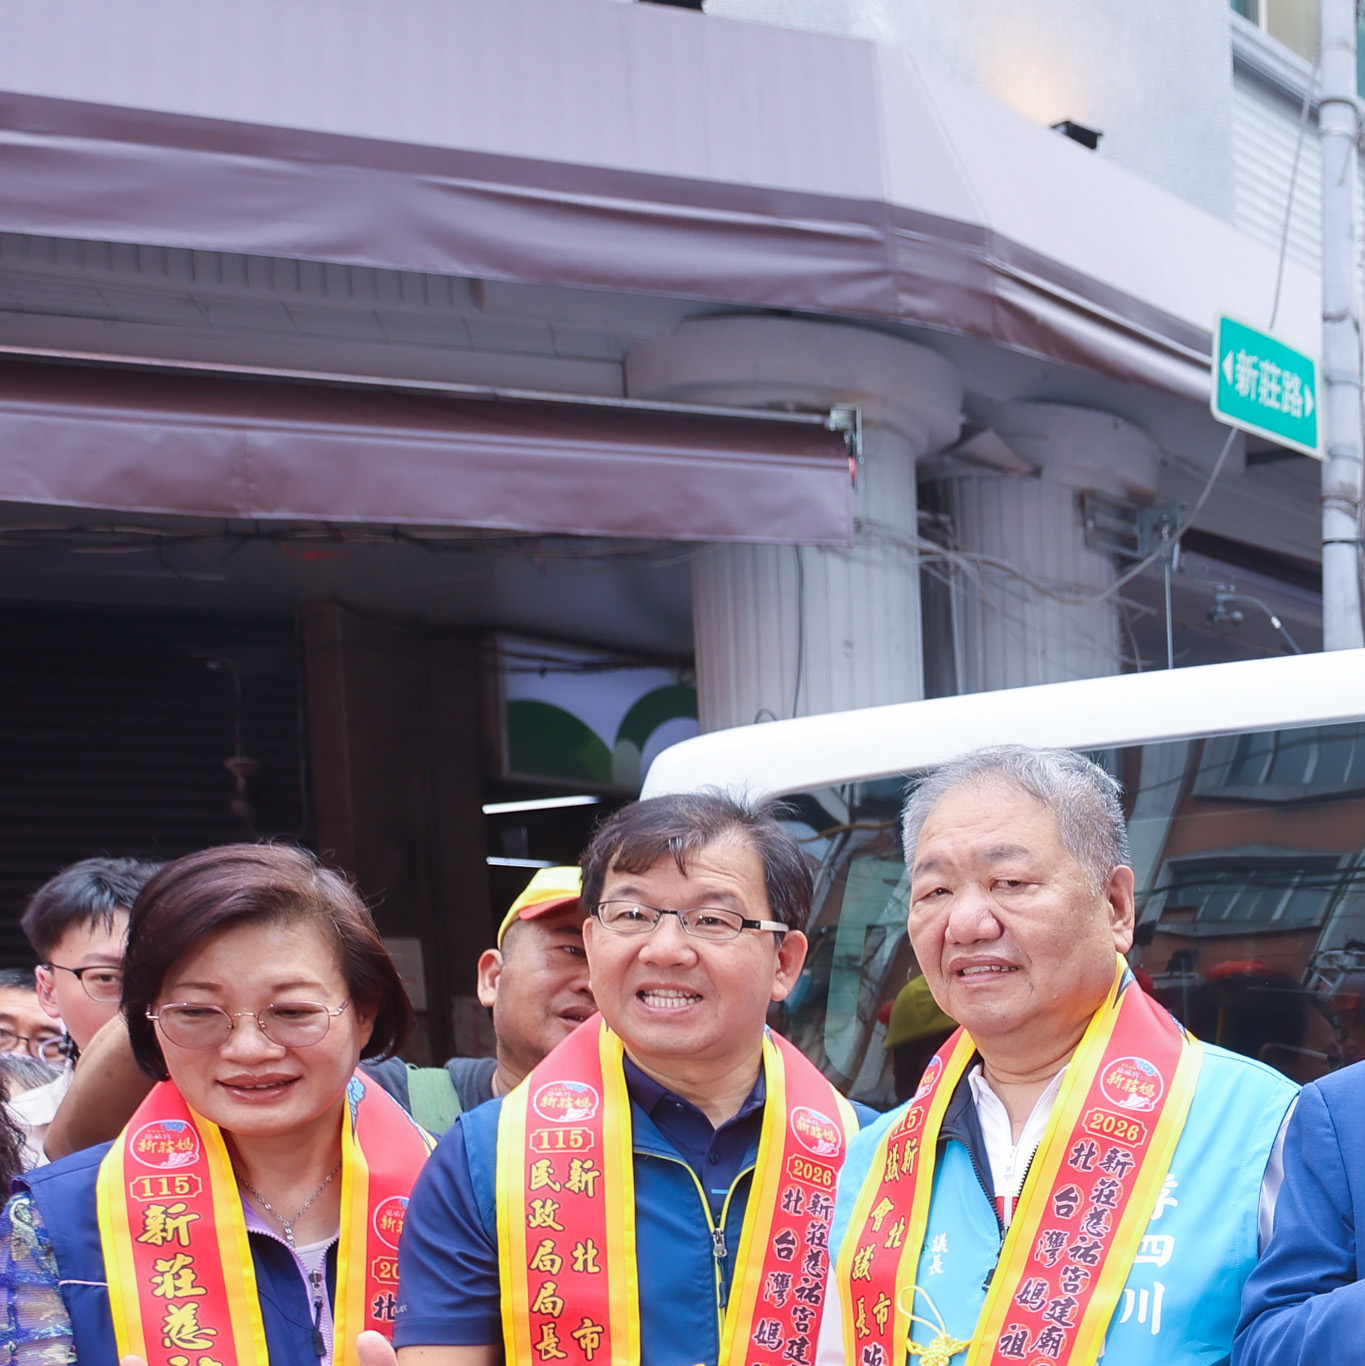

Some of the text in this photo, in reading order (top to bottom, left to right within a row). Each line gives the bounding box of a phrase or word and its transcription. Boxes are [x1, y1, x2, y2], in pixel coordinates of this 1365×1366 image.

[1235, 348, 1304, 419] 新莊路
[540, 1129, 583, 1149] 115
[1089, 1113, 1139, 1141] 2026
[141, 1177, 190, 1197] 115
[793, 1160, 832, 1186] 2026
[527, 1158, 567, 1361] 民政局局長
[928, 1232, 948, 1276] 議長
